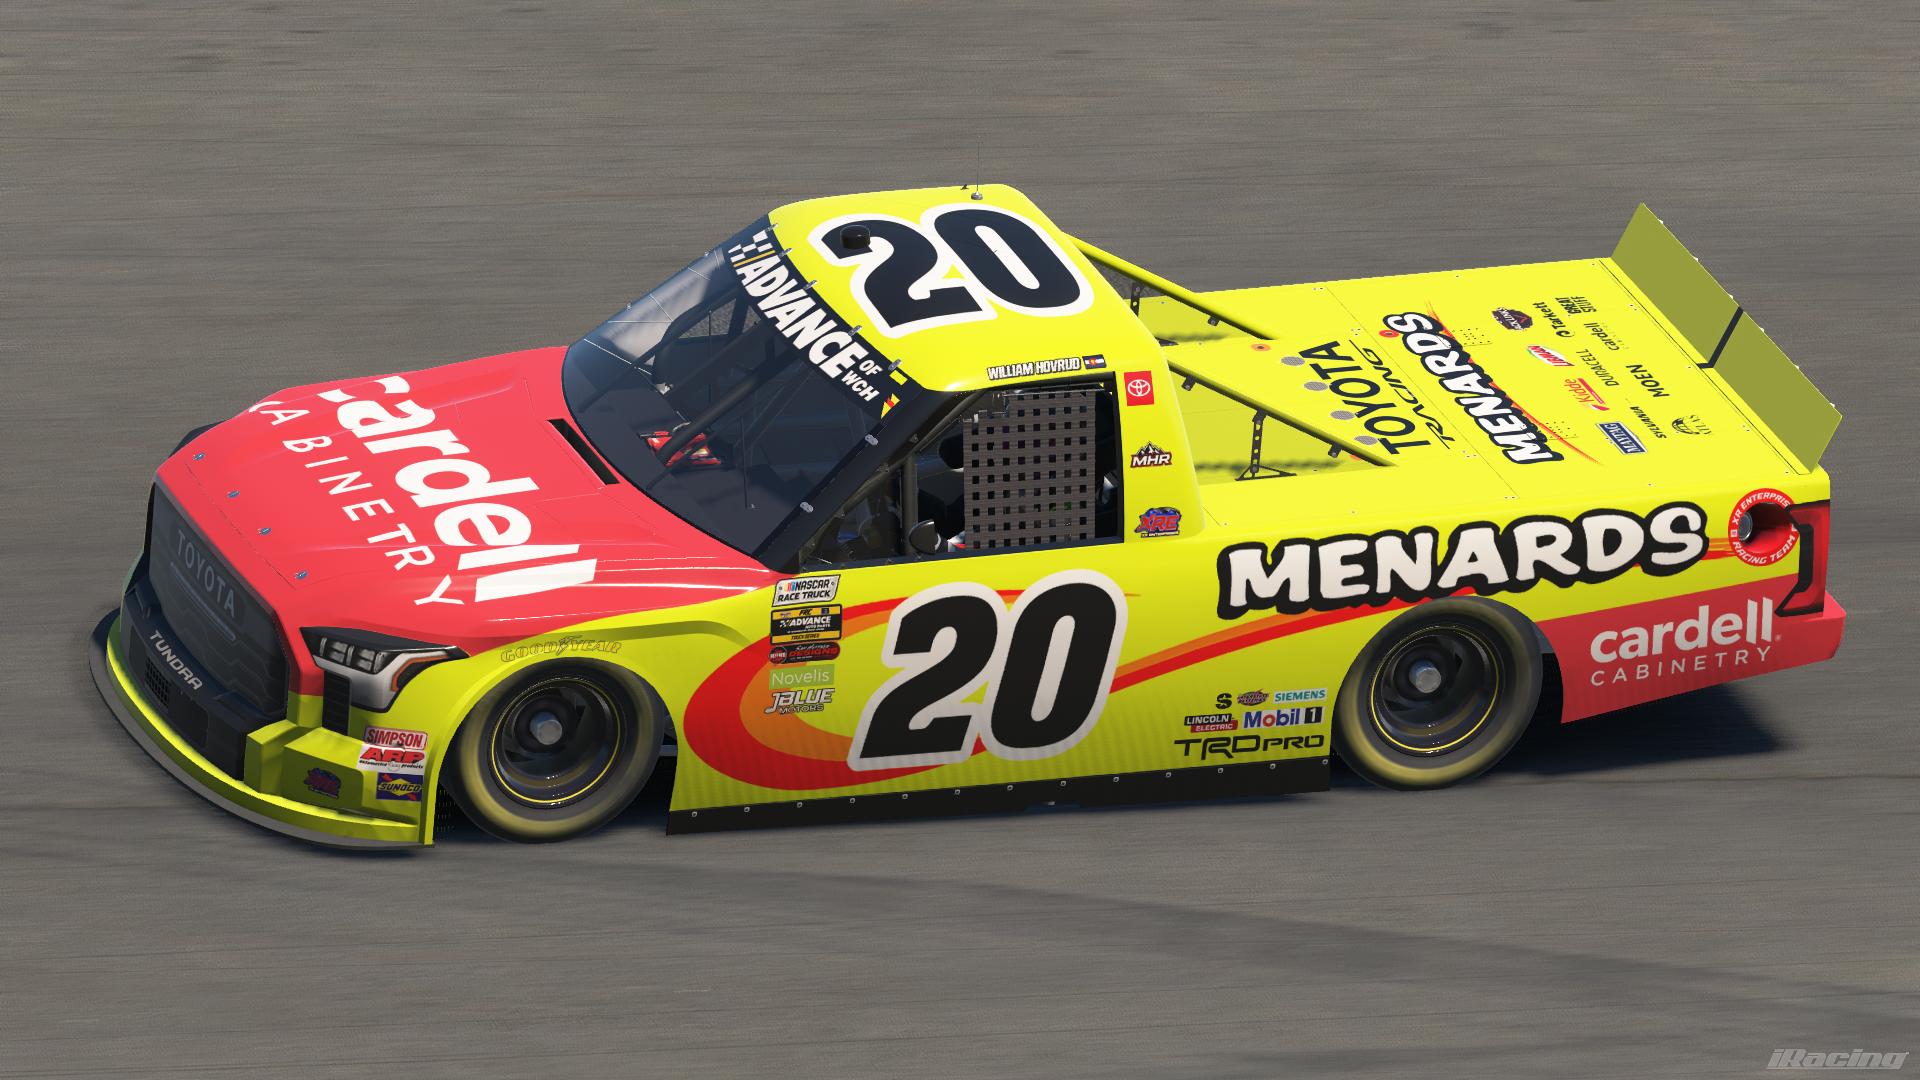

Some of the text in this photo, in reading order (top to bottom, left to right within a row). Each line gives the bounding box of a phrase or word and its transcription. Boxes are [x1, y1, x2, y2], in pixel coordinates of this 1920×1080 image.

[820, 208, 1081, 329] 20
[735, 254, 883, 379] ADVANCE OF
[1532, 301, 1567, 330] Tarkett
[1555, 297, 1582, 315] GREAT
[1571, 296, 1597, 313] STUFF
[1584, 322, 1620, 350] cardell
[988, 357, 1081, 380] WILLIAM HOVRUD
[1576, 349, 1620, 387] DURACELL
[1626, 364, 1670, 398] MOEN
[841, 370, 880, 402] WCH
[1299, 341, 1430, 455] TOYOTA
[1348, 340, 1456, 449] RACING
[1384, 313, 1561, 463] MENARDS
[1565, 378, 1595, 403] Kidde
[1630, 406, 1667, 439] SYLVANIA
[1604, 423, 1641, 453] MAYTAG
[1131, 453, 1171, 467] MHR
[1138, 514, 1179, 531] XRE
[1731, 509, 1743, 526] XR
[1225, 504, 1705, 612] MENARDS
[1733, 534, 1796, 565] RACING TEAM
[178, 529, 236, 618] TOYOTA
[795, 579, 830, 591] NASCAR
[777, 589, 830, 602] RACE TRUCK
[789, 616, 832, 627] ADVANCE
[1590, 596, 1773, 664] cardell
[150, 629, 203, 691] TUNDRA
[500, 636, 623, 663] GOODYEAR
[771, 668, 831, 687] Novelis
[858, 581, 1117, 760] 20
[1590, 645, 1771, 687] CABINETRY
[1274, 689, 1326, 702] SIEMENS
[779, 703, 825, 715] MOTORS
[1186, 714, 1230, 725] LINCOLN
[1243, 708, 1301, 729] Mobil
[366, 728, 424, 748] SIMPSON
[1195, 723, 1234, 733] ELECTRIC
[359, 746, 425, 764] ARP
[1174, 735, 1325, 761] TRD PRO
[379, 782, 422, 792] SUNOCO
